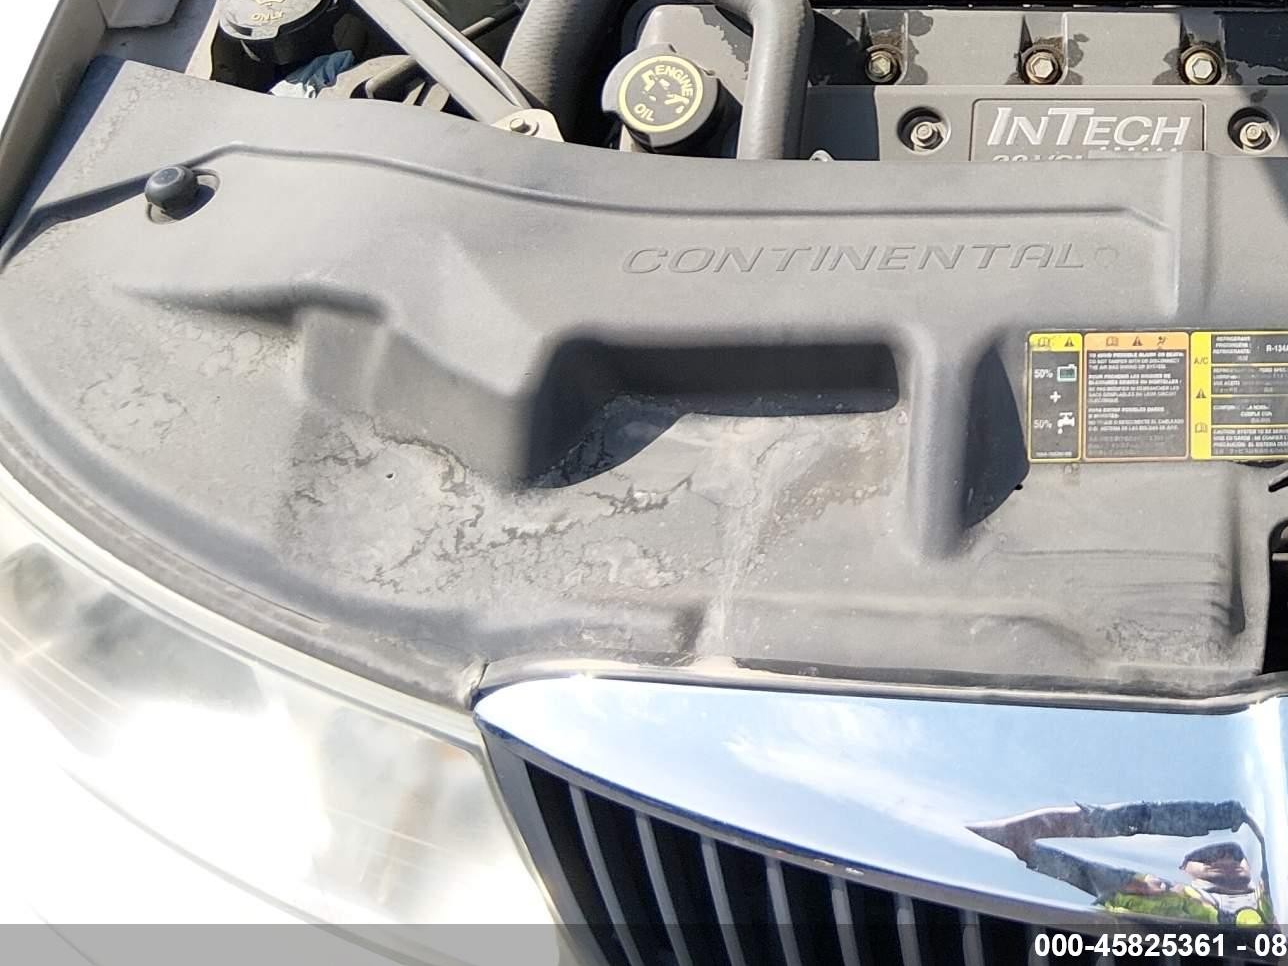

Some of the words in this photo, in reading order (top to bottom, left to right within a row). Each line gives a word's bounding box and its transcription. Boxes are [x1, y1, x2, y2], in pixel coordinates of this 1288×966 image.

[251, 10, 285, 22] ONLY
[654, 64, 694, 98] ENGINE
[633, 103, 655, 122] OIL
[621, 241, 1086, 275] CONTINENTAL
[1194, 356, 1208, 365] A/C
[1034, 368, 1053, 378] 50%
[1033, 419, 1053, 429] 50%
